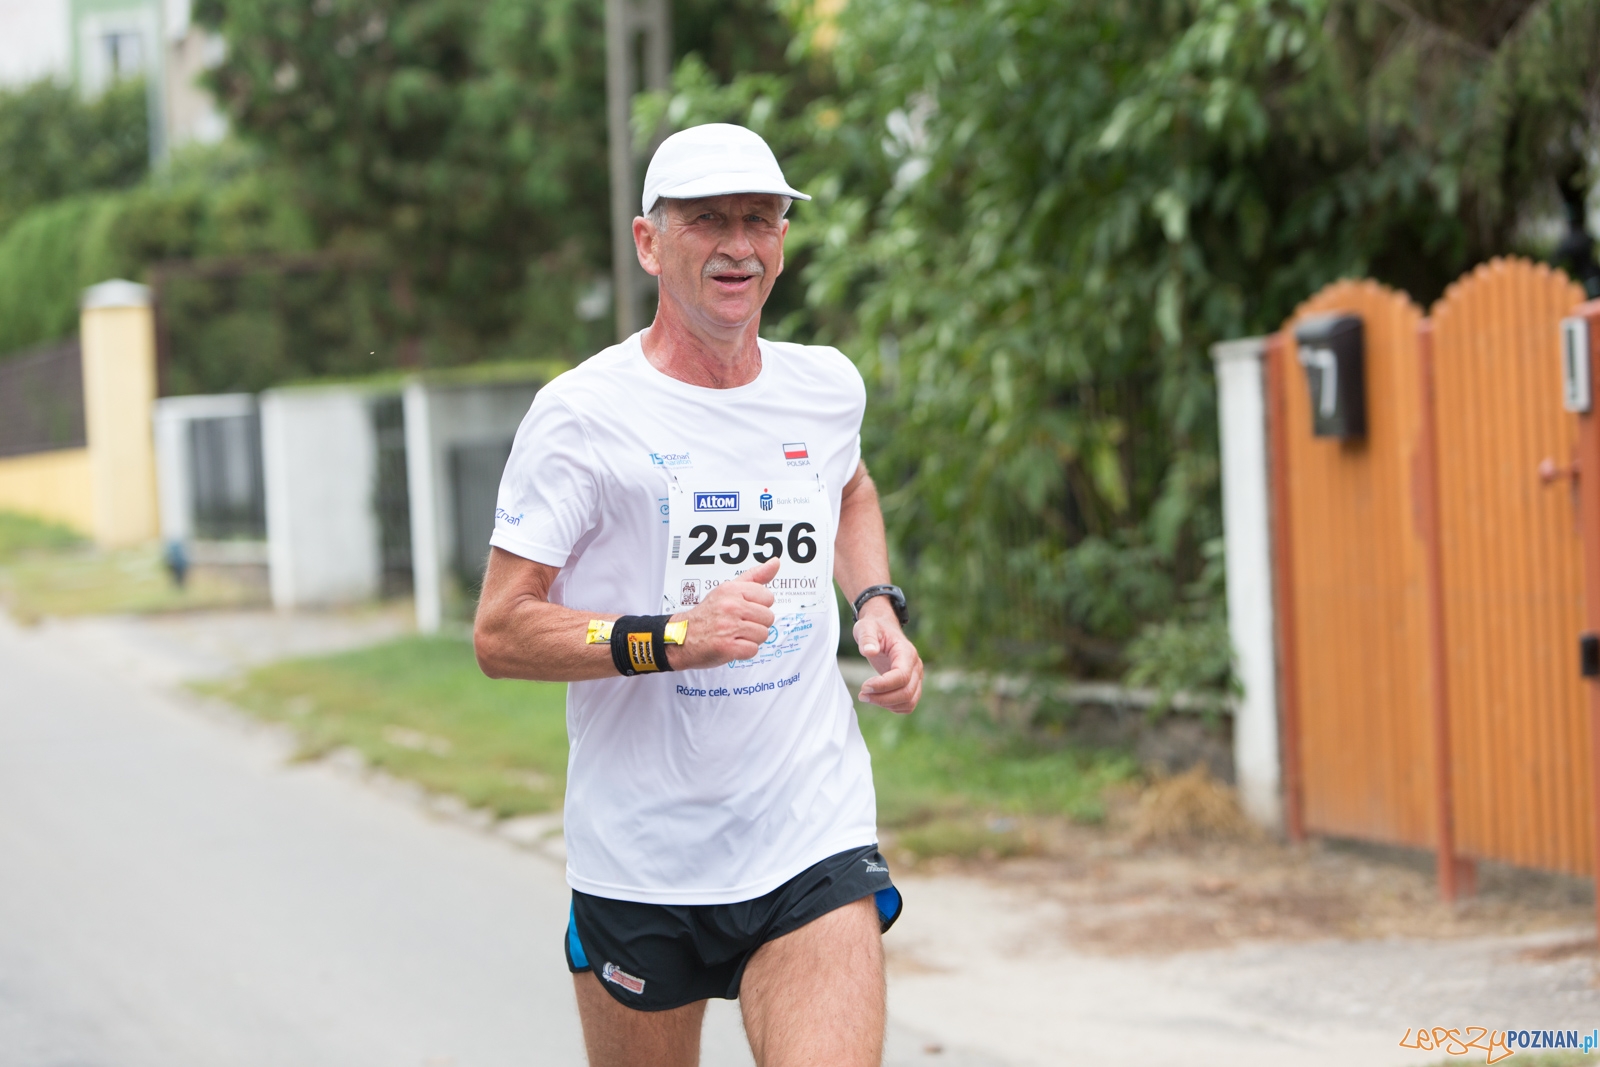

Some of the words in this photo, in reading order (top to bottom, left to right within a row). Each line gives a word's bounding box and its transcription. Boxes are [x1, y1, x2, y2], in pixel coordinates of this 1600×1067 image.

[776, 497, 791, 505] Bank
[793, 497, 810, 505] Polski
[685, 522, 817, 565] 2556
[676, 685, 706, 697] Różne
[709, 687, 730, 697] cele,
[733, 681, 775, 695] wspólna
